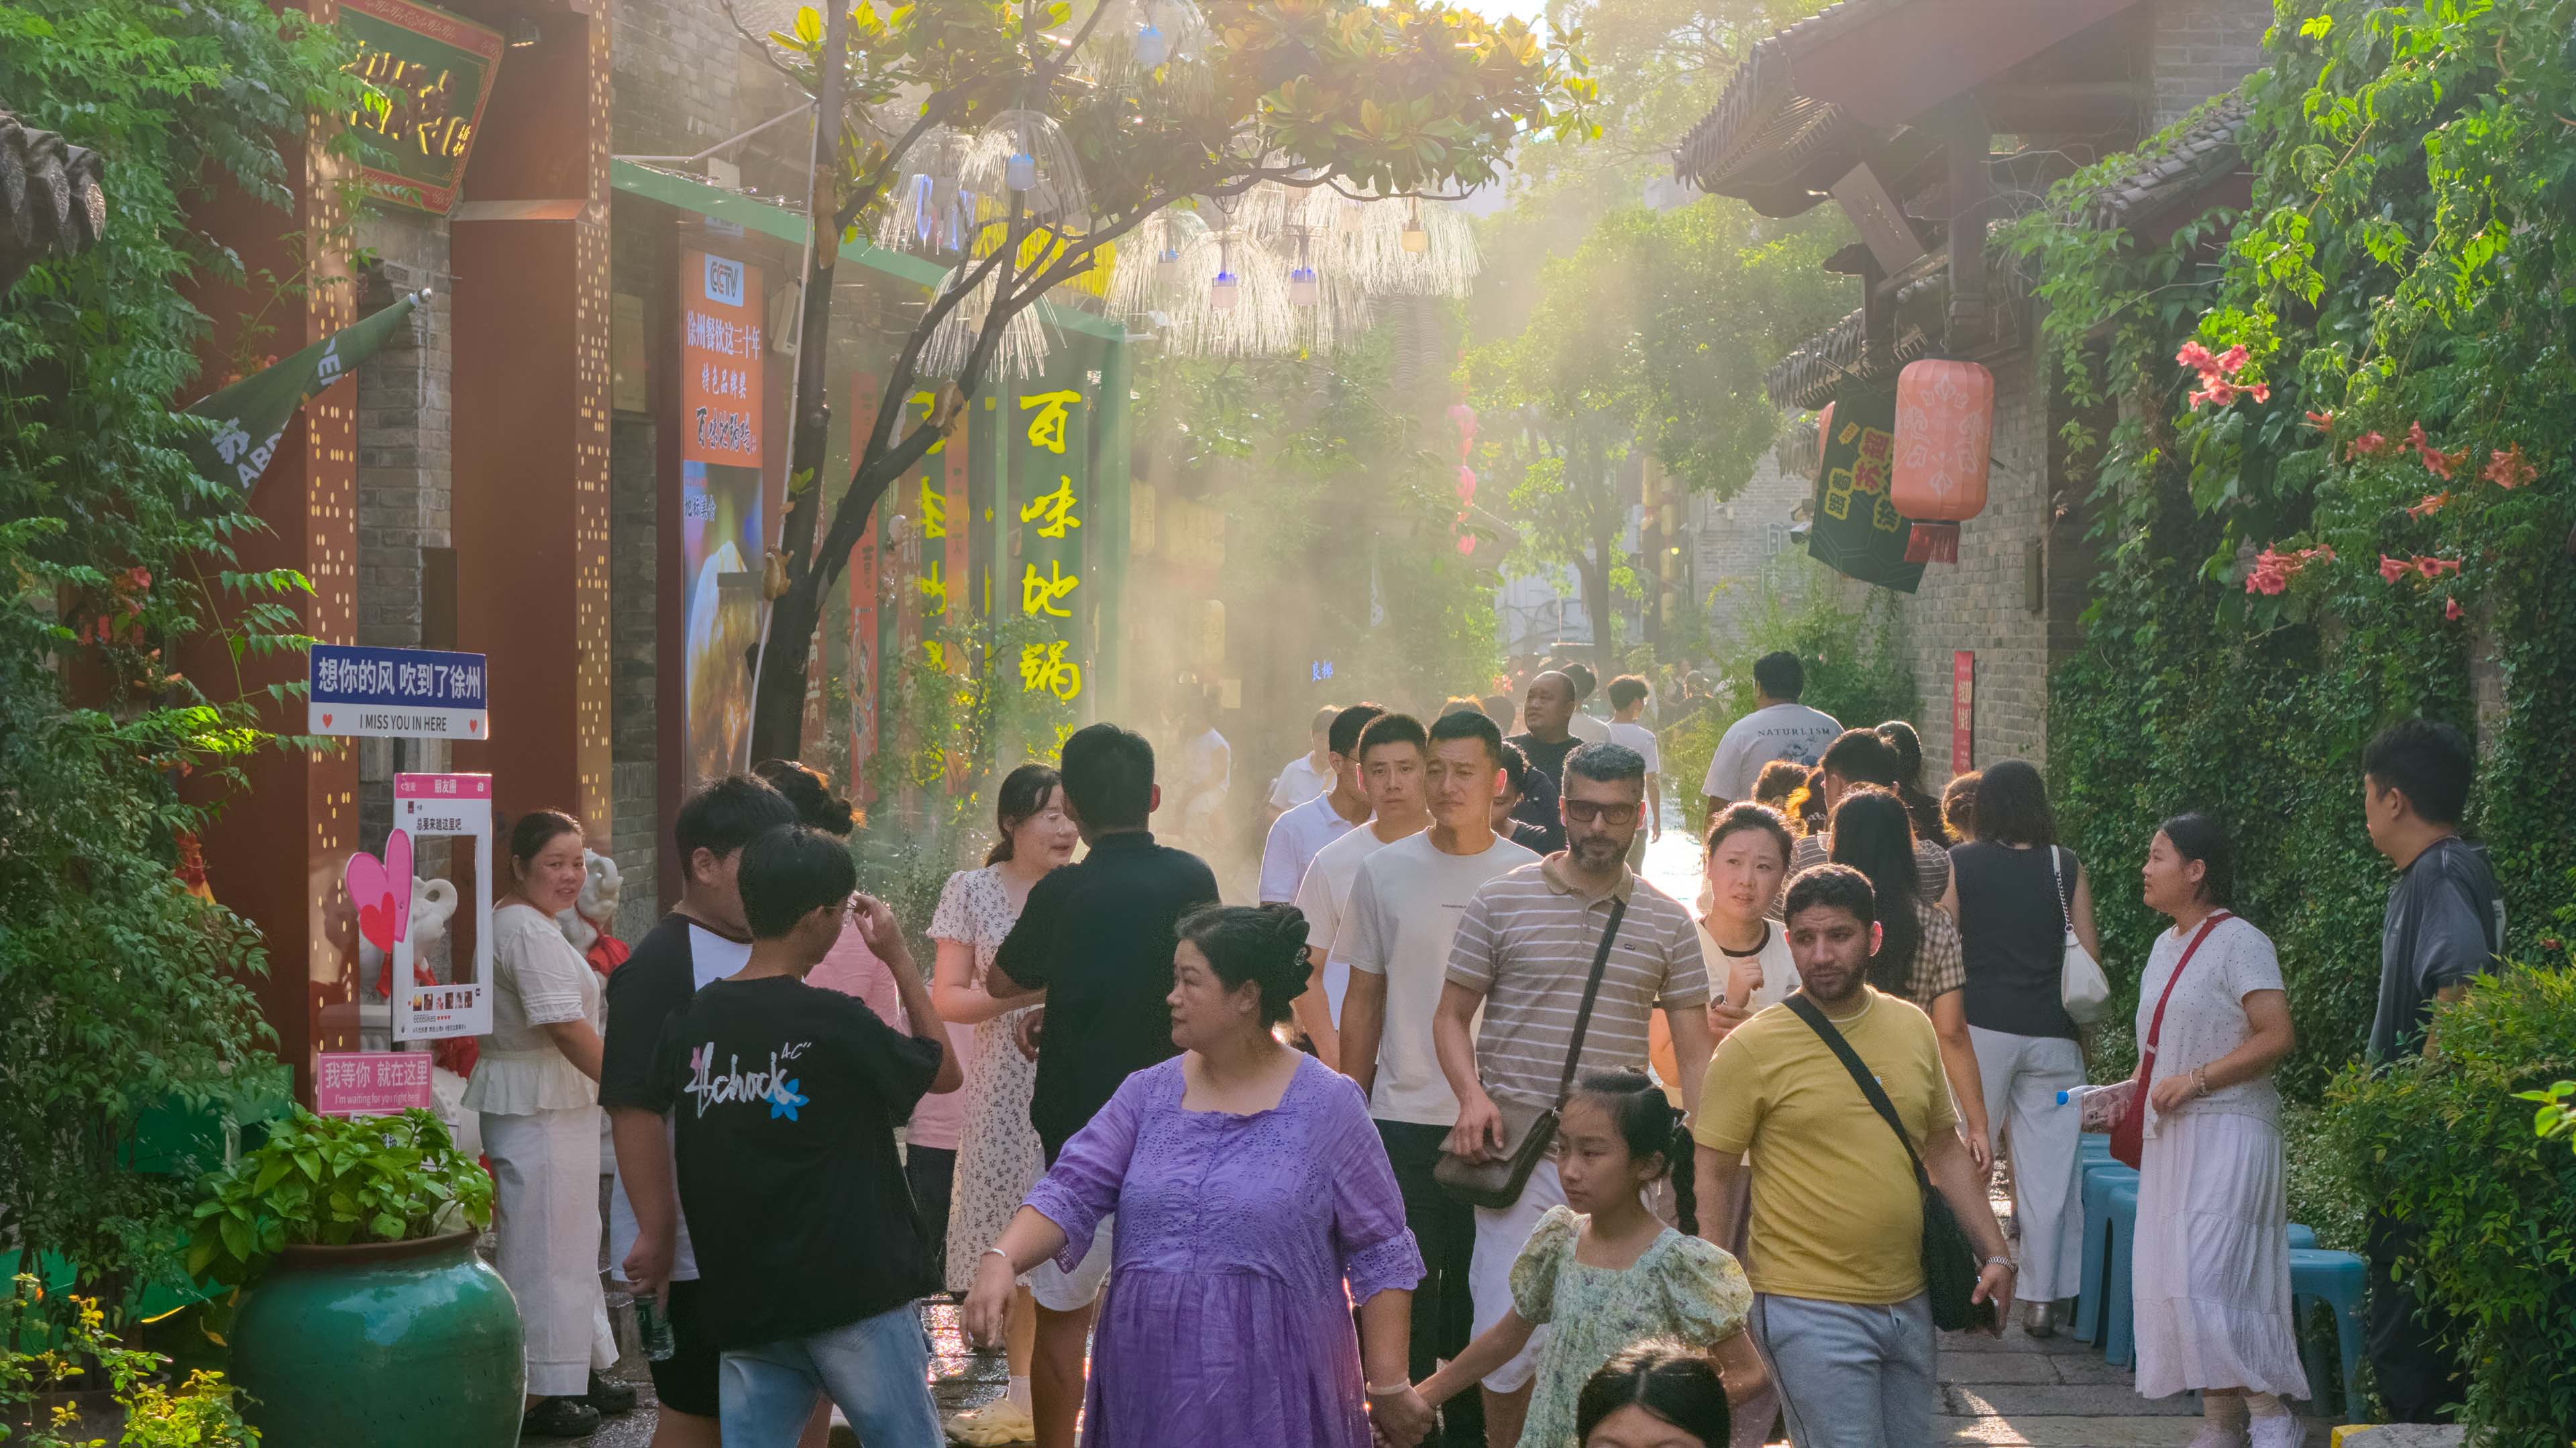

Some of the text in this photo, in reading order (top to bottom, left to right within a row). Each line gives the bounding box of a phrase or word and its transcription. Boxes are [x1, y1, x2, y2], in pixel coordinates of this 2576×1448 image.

[710, 262, 738, 297] CCTV
[1019, 389, 1081, 758] 百味地锅
[319, 657, 480, 699] 想你的风 吹到了徐州
[360, 713, 447, 731] I MISS YOU IN HERE
[1758, 727, 1831, 737] NATURLISM
[435, 779, 457, 794] 朋友圈
[325, 1060, 428, 1089] 我等你 就在这里
[335, 1092, 419, 1106] I'm waiting for you right here
